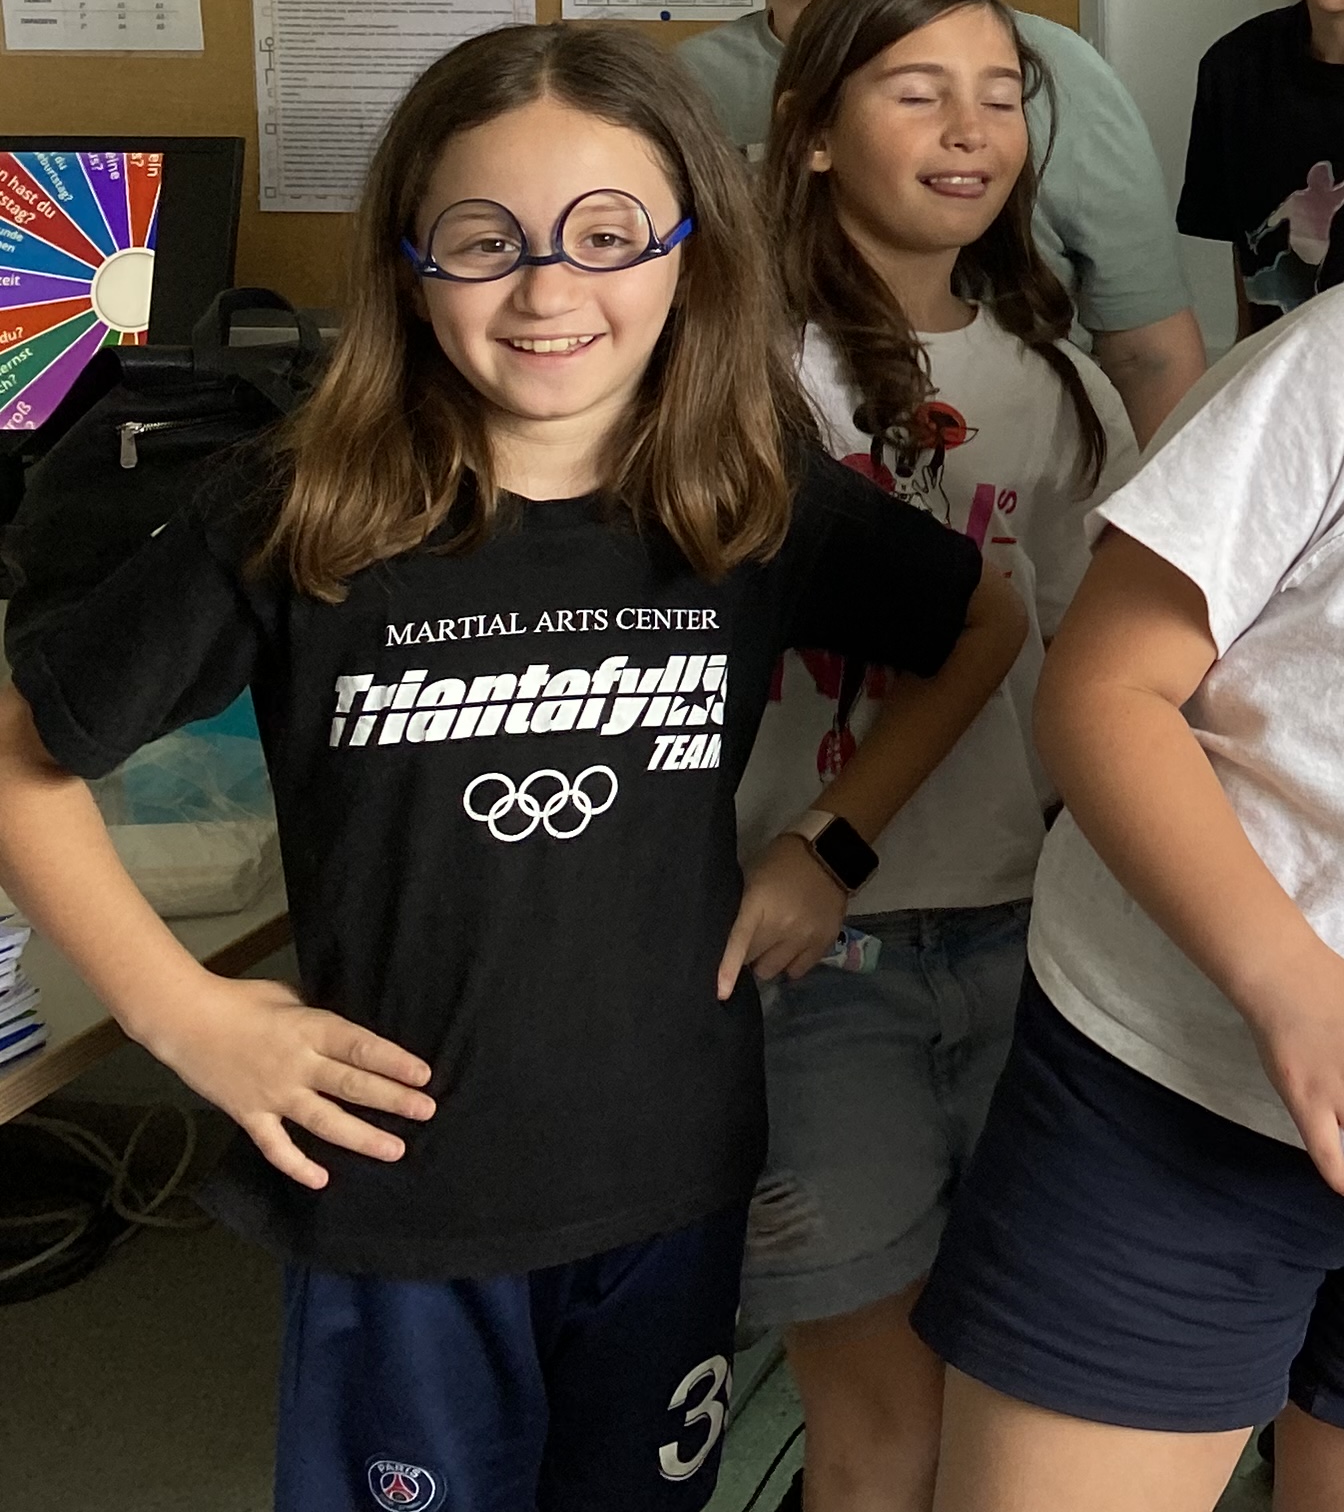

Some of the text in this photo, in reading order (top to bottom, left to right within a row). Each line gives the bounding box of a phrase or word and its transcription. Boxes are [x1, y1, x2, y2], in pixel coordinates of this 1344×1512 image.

[37, 199, 56, 219] du
[386, 608, 720, 647] MARTIAL ARTS CENTER
[647, 733, 720, 771] TEAM
[659, 1354, 734, 1481] 3
